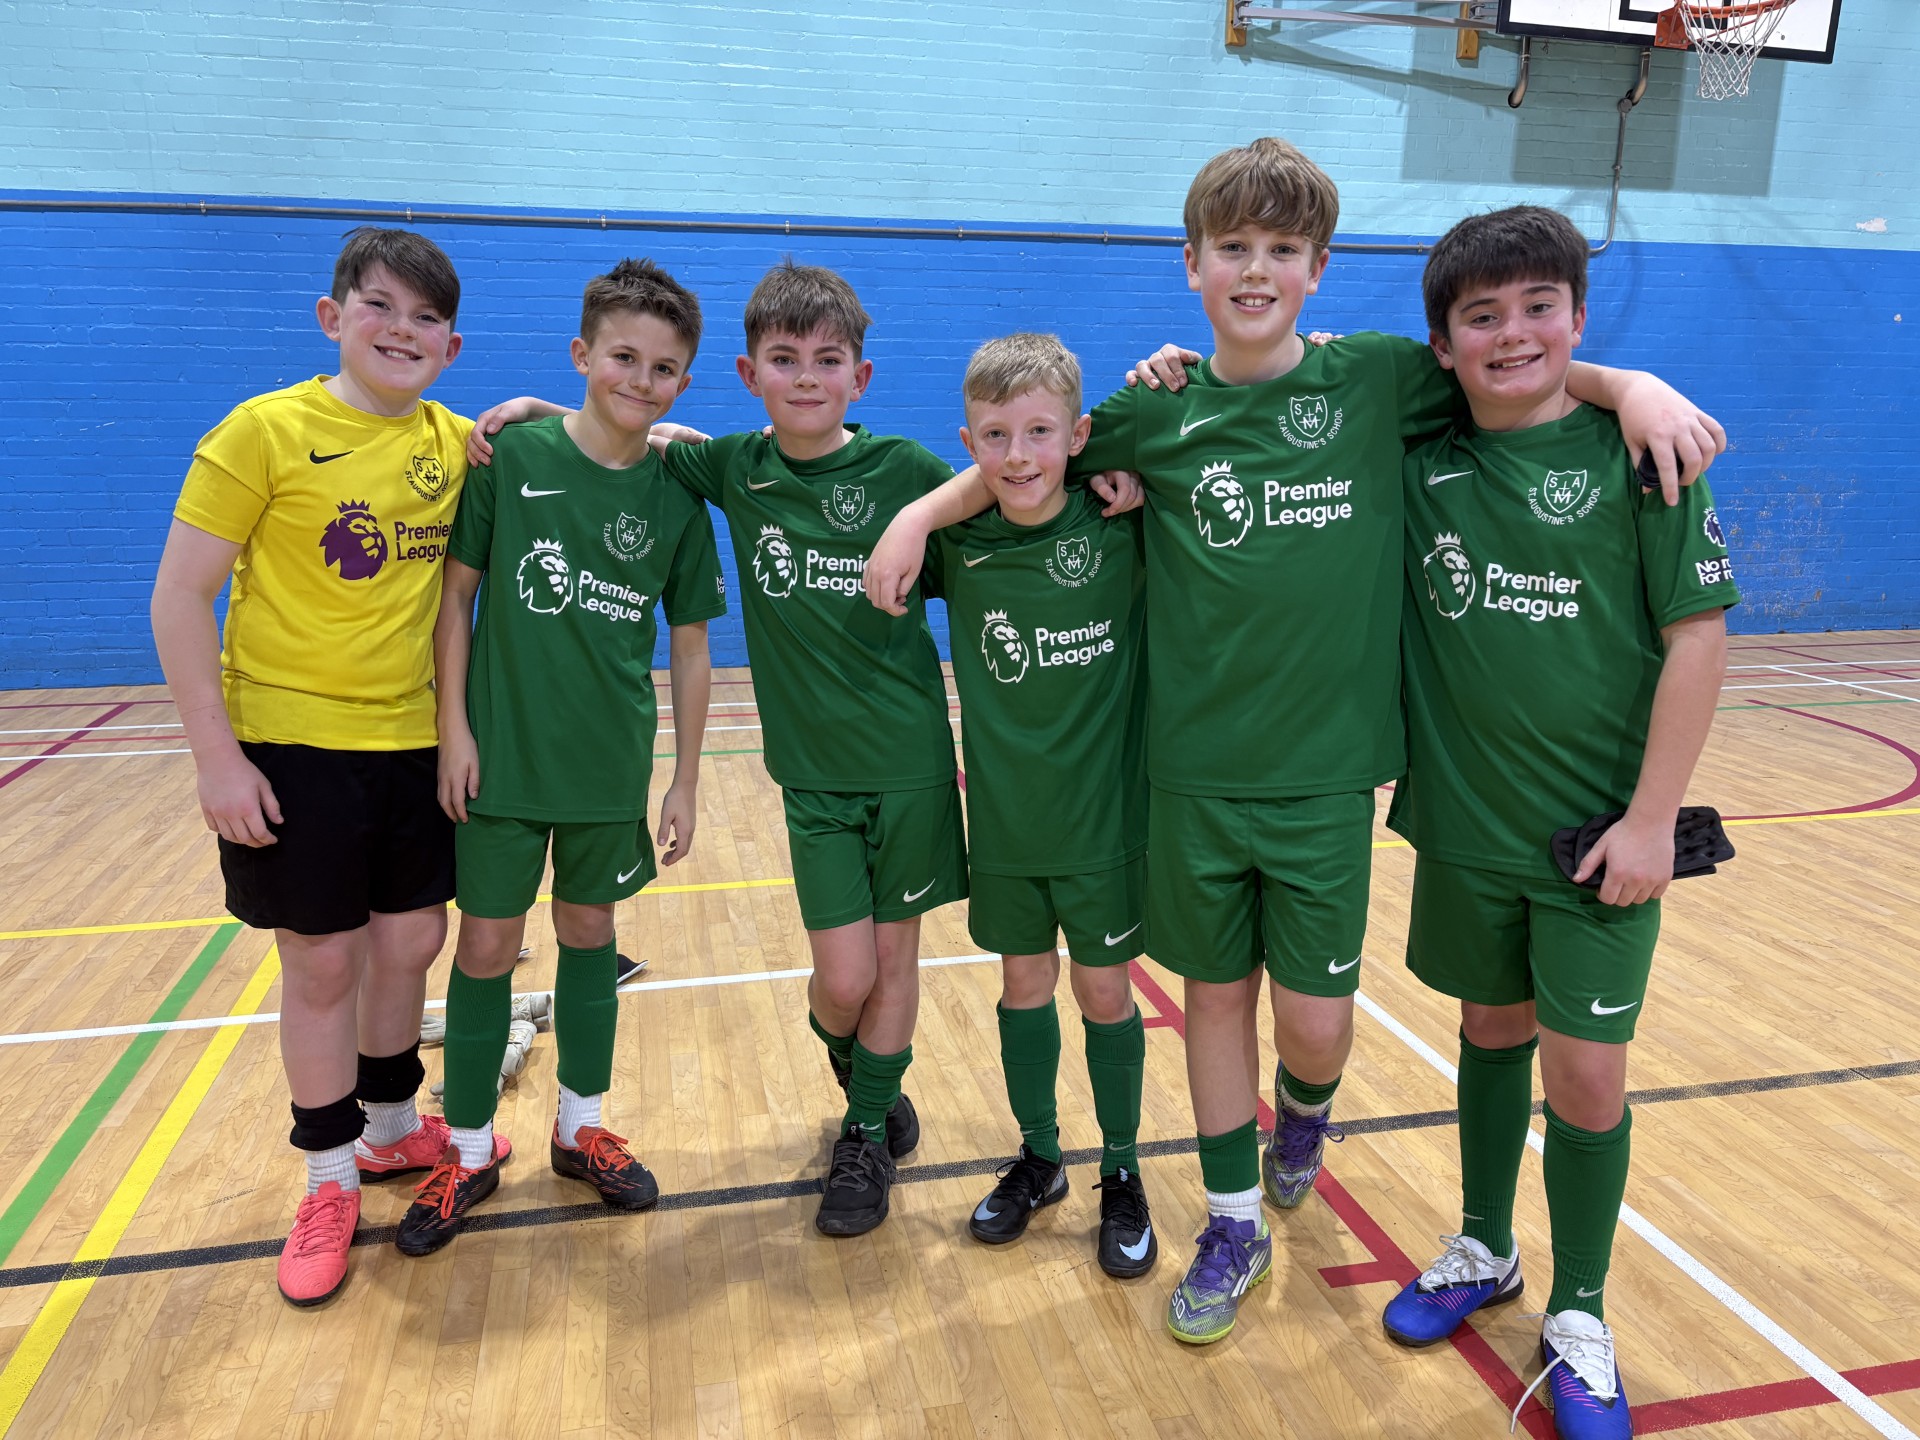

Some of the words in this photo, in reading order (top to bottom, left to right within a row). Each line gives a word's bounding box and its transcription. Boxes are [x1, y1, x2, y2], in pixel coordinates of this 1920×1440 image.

[1294, 403, 1302, 415] S
[1315, 402, 1323, 413] A
[1327, 408, 1343, 440] SCHOOL
[416, 462, 423, 472] S
[432, 462, 440, 472] A
[1264, 477, 1352, 504] Premier
[1549, 477, 1558, 488] S
[1572, 476, 1581, 488] A
[836, 491, 843, 500] S
[854, 491, 861, 501] A
[1576, 486, 1601, 518] SCHOOL
[860, 501, 876, 526] SCHOOL
[1265, 503, 1352, 528] League
[619, 519, 627, 529] S
[636, 525, 642, 535] A
[396, 541, 445, 563] Leagu
[636, 537, 655, 559] SCHOOL
[1060, 546, 1067, 557] S
[1079, 544, 1086, 554] A
[806, 549, 870, 573] Premi
[1088, 549, 1103, 578] SCHOOL
[1695, 560, 1720, 575] No
[579, 570, 649, 607] Premier
[805, 569, 867, 597] Leagu
[1486, 563, 1582, 595] Premier
[1699, 571, 1721, 586] for
[579, 588, 642, 622] League
[1483, 586, 1579, 622] League
[1035, 619, 1112, 647] Premier
[1038, 638, 1115, 667] League
